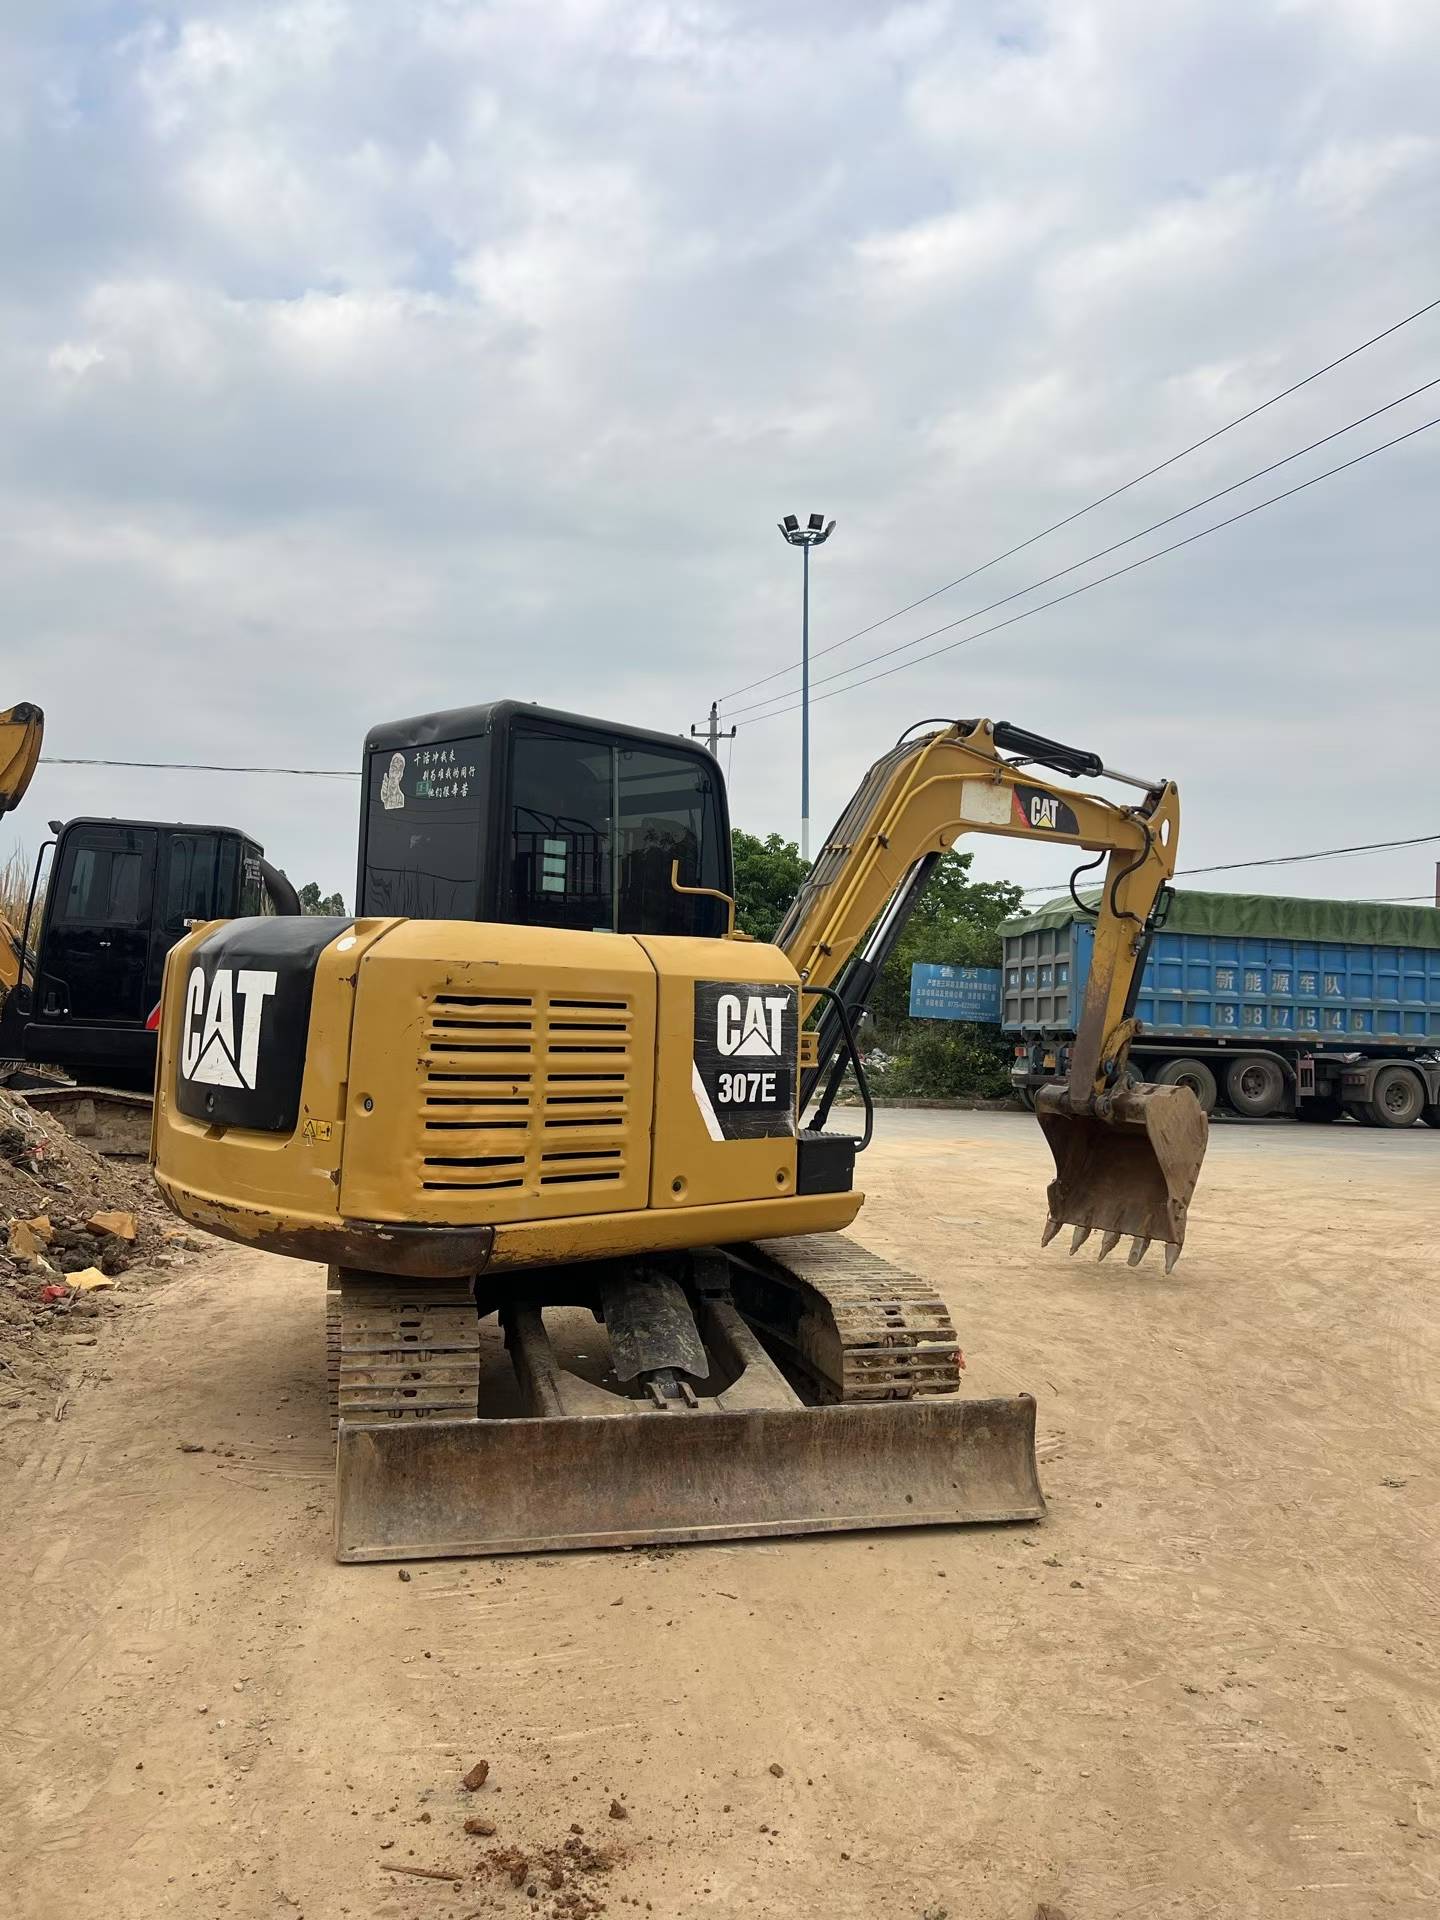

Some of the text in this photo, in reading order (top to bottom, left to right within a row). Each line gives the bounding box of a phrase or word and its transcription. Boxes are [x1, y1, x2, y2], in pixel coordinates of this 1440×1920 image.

[1030, 796, 1059, 829] CAT
[1215, 970, 1342, 995] 新能源车队
[181, 966, 278, 1090] CAT
[717, 993, 791, 1056] CAT
[718, 1073, 776, 1103] 307E
